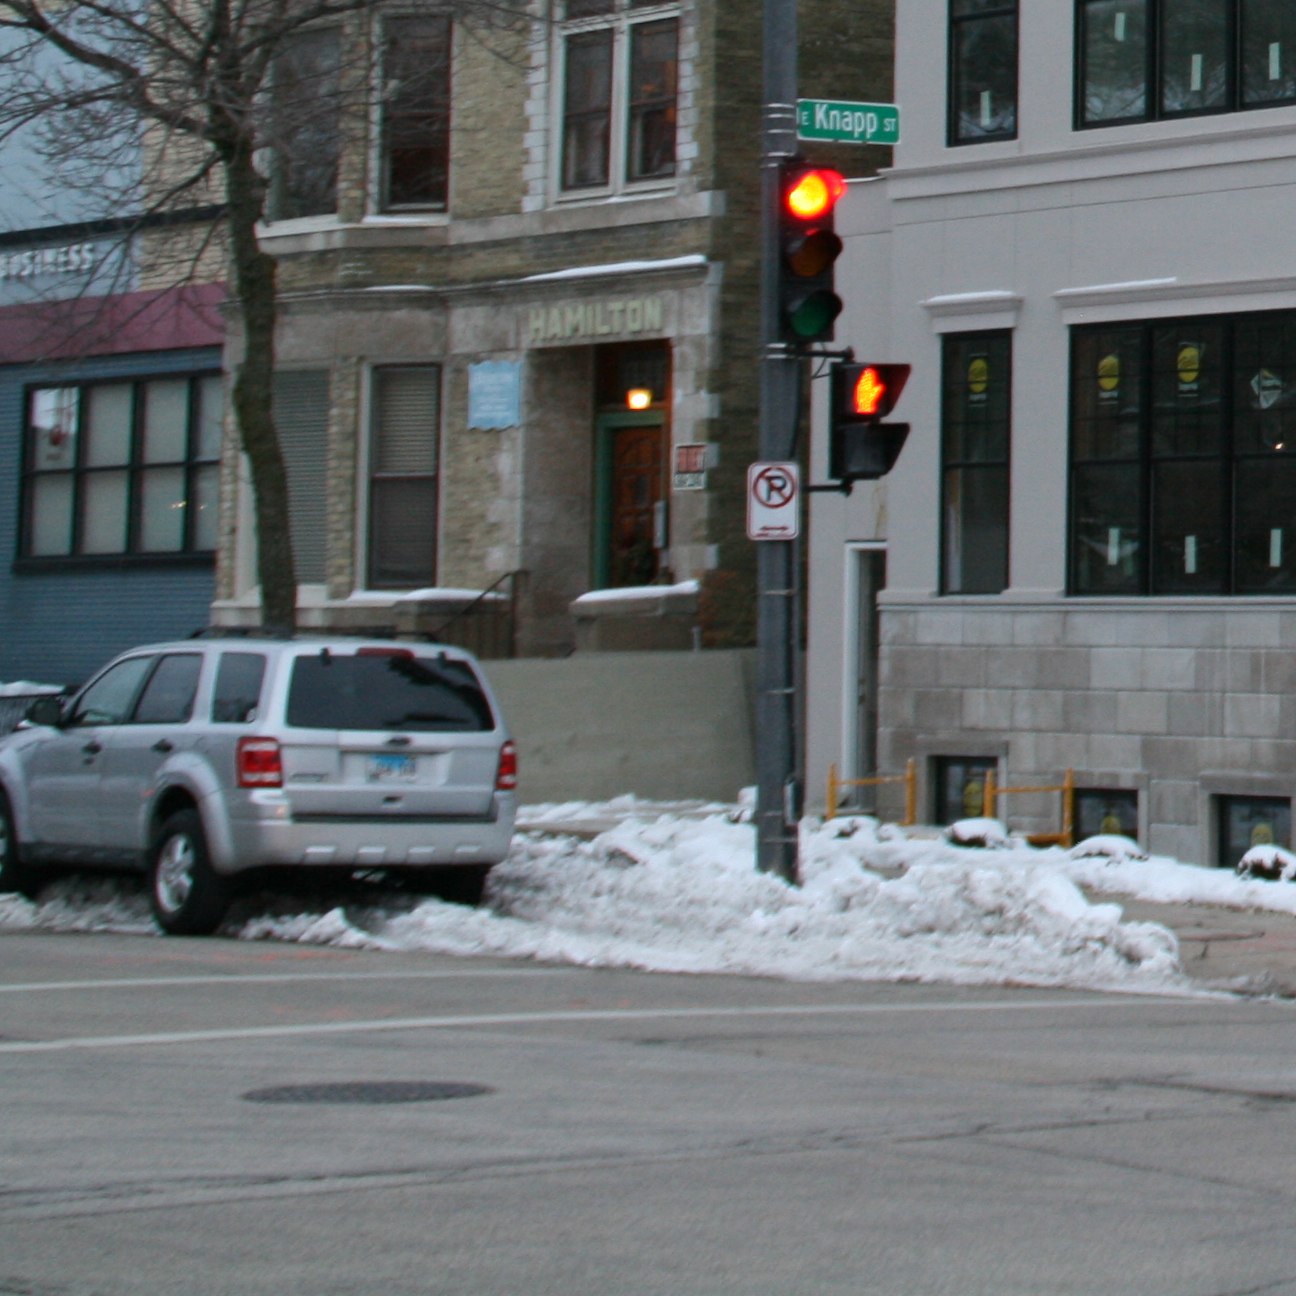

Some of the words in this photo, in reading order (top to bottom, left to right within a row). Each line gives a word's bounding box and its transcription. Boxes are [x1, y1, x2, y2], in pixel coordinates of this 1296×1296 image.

[802, 111, 810, 125] E
[815, 104, 877, 139] Knapp
[883, 118, 896, 132] ST
[529, 298, 663, 338] HAMILTON
